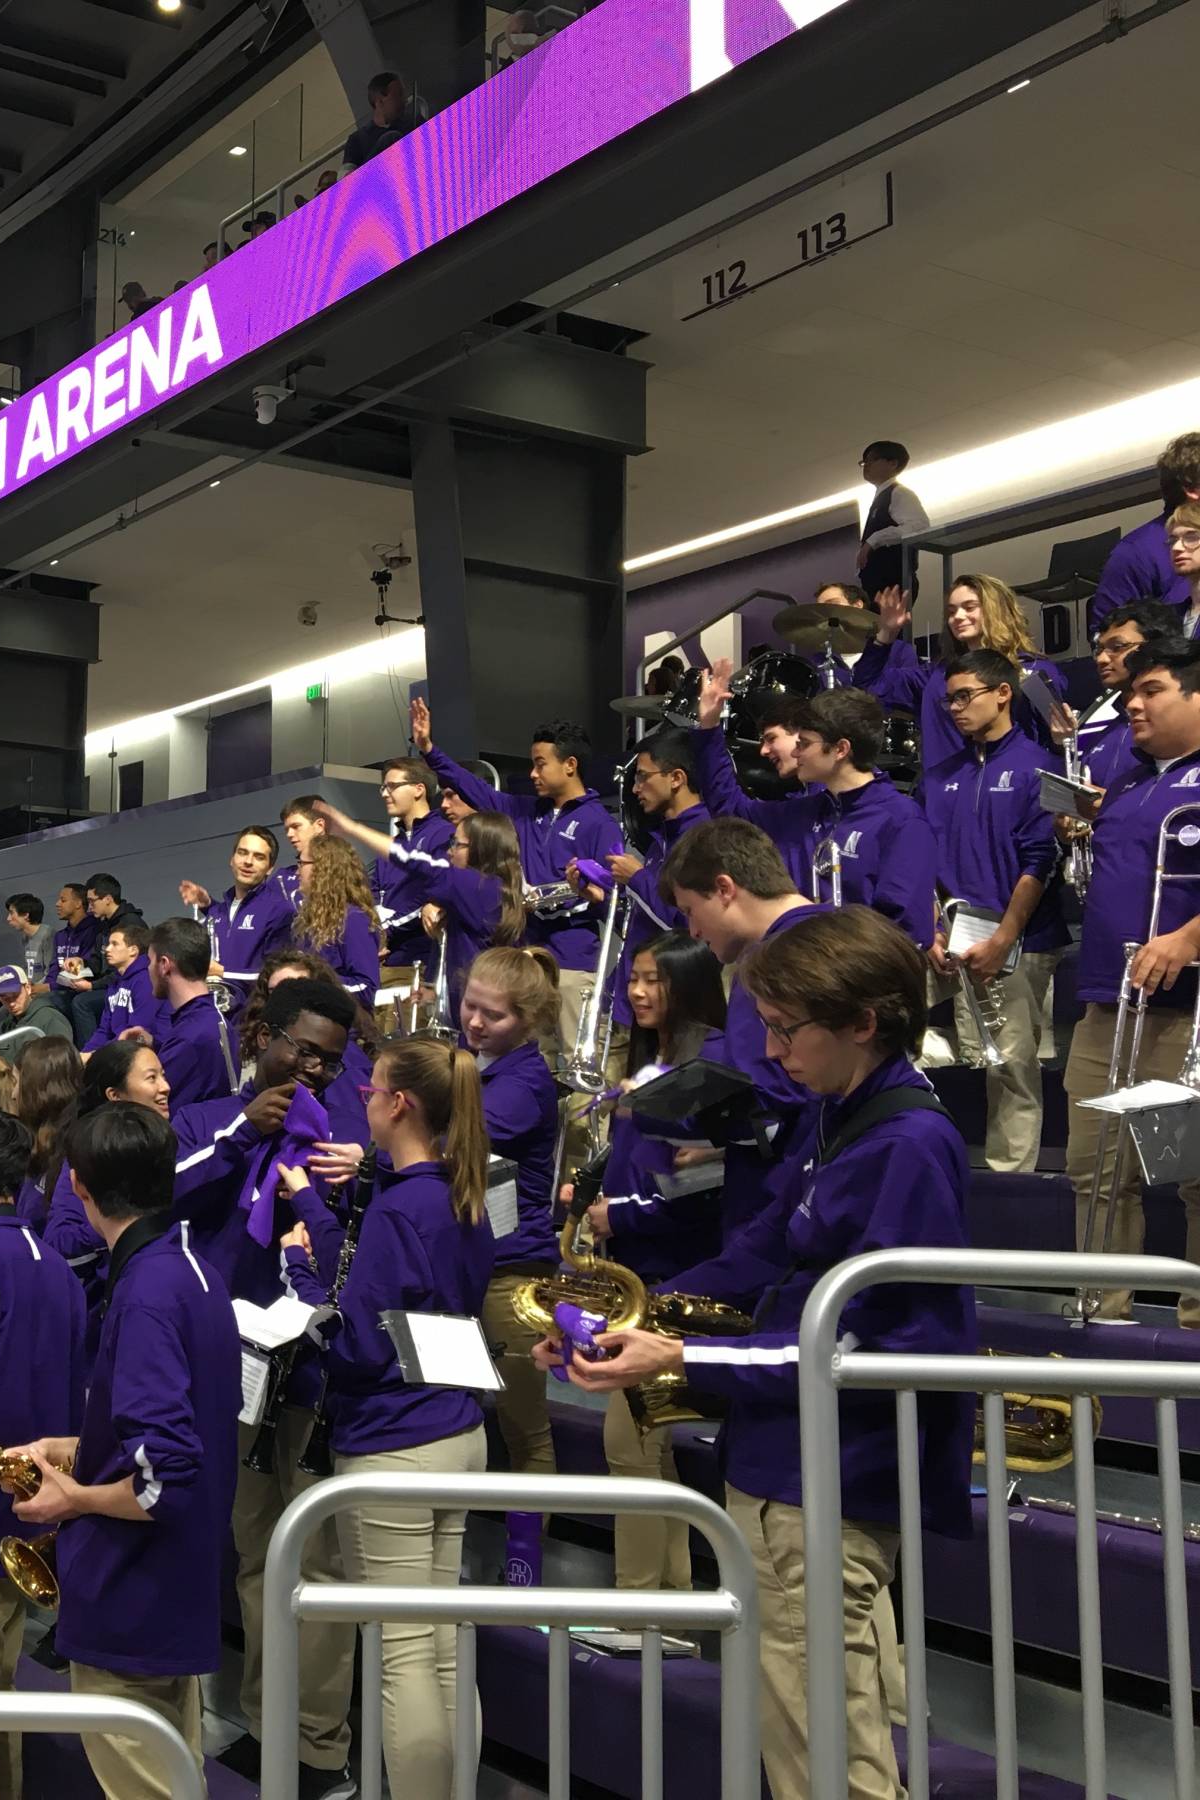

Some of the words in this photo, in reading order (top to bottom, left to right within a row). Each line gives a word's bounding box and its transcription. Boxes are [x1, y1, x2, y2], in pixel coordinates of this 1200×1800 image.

[97, 228, 127, 247] 214
[702, 260, 748, 305] 112
[797, 212, 847, 260] 113
[16, 284, 224, 479] ARENA
